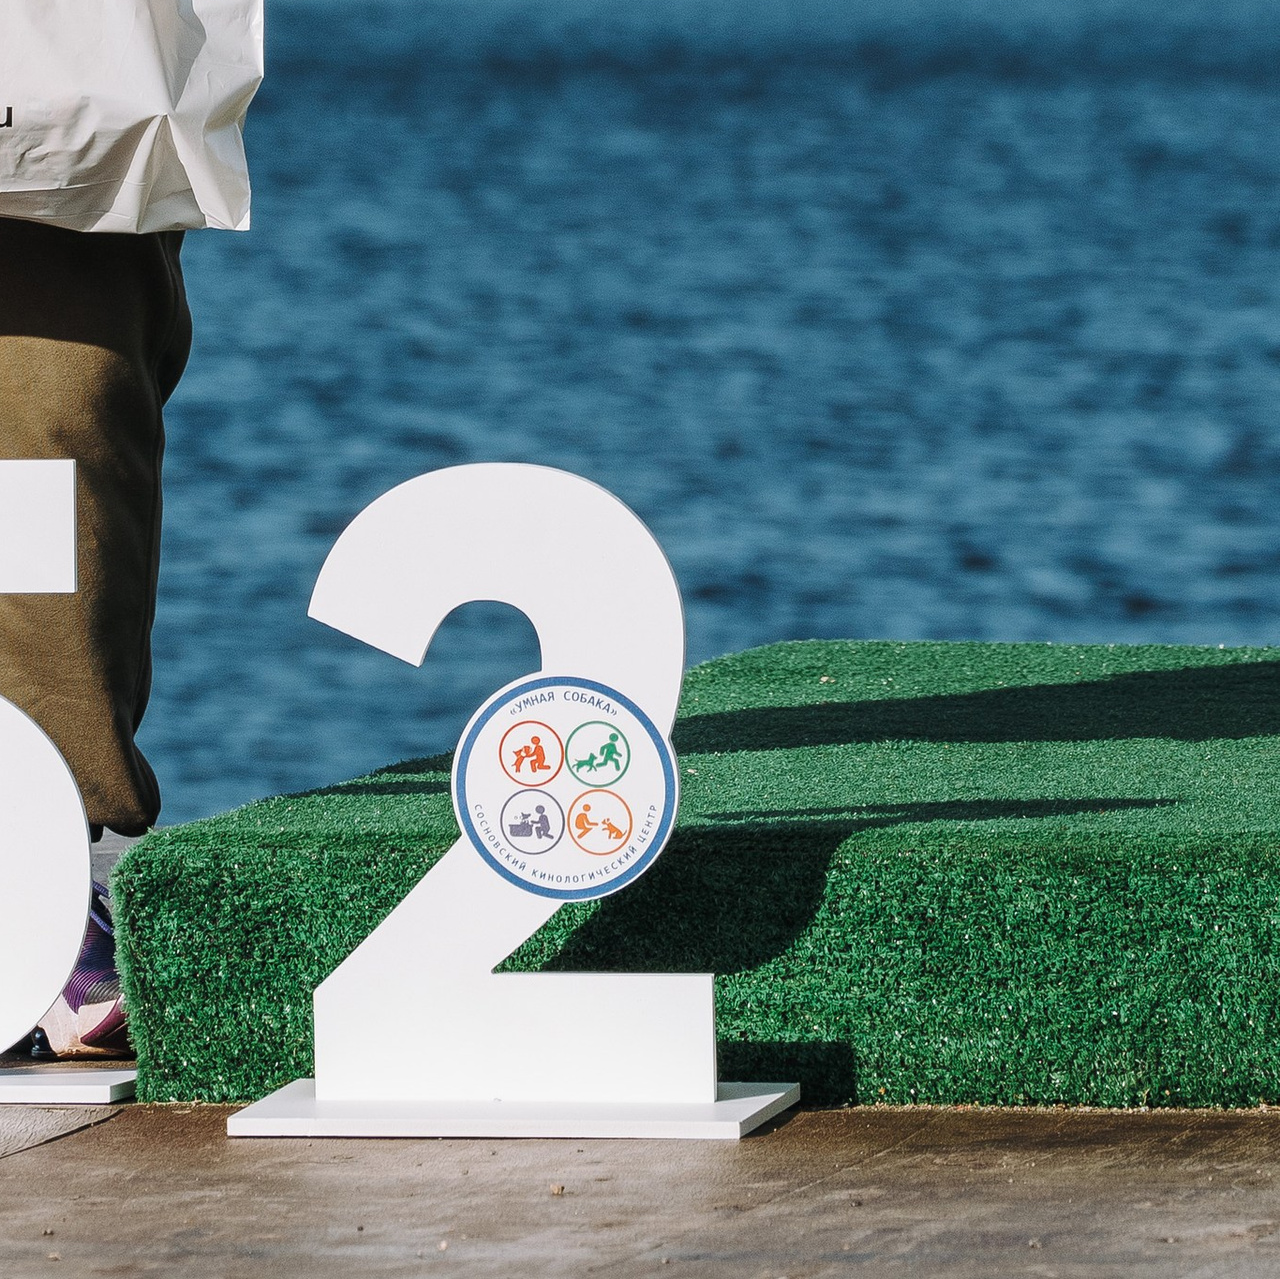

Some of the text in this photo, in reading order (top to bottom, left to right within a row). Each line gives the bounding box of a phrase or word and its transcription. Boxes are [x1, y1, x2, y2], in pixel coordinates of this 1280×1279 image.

[509, 690, 618, 717] «УМНАЯ СОБАКА»
[307, 462, 716, 1103] 2
[473, 803, 658, 884] СОСНОВСКИЙ КИНОЛОГИЧЕСКИЙ ЦЕНТР
